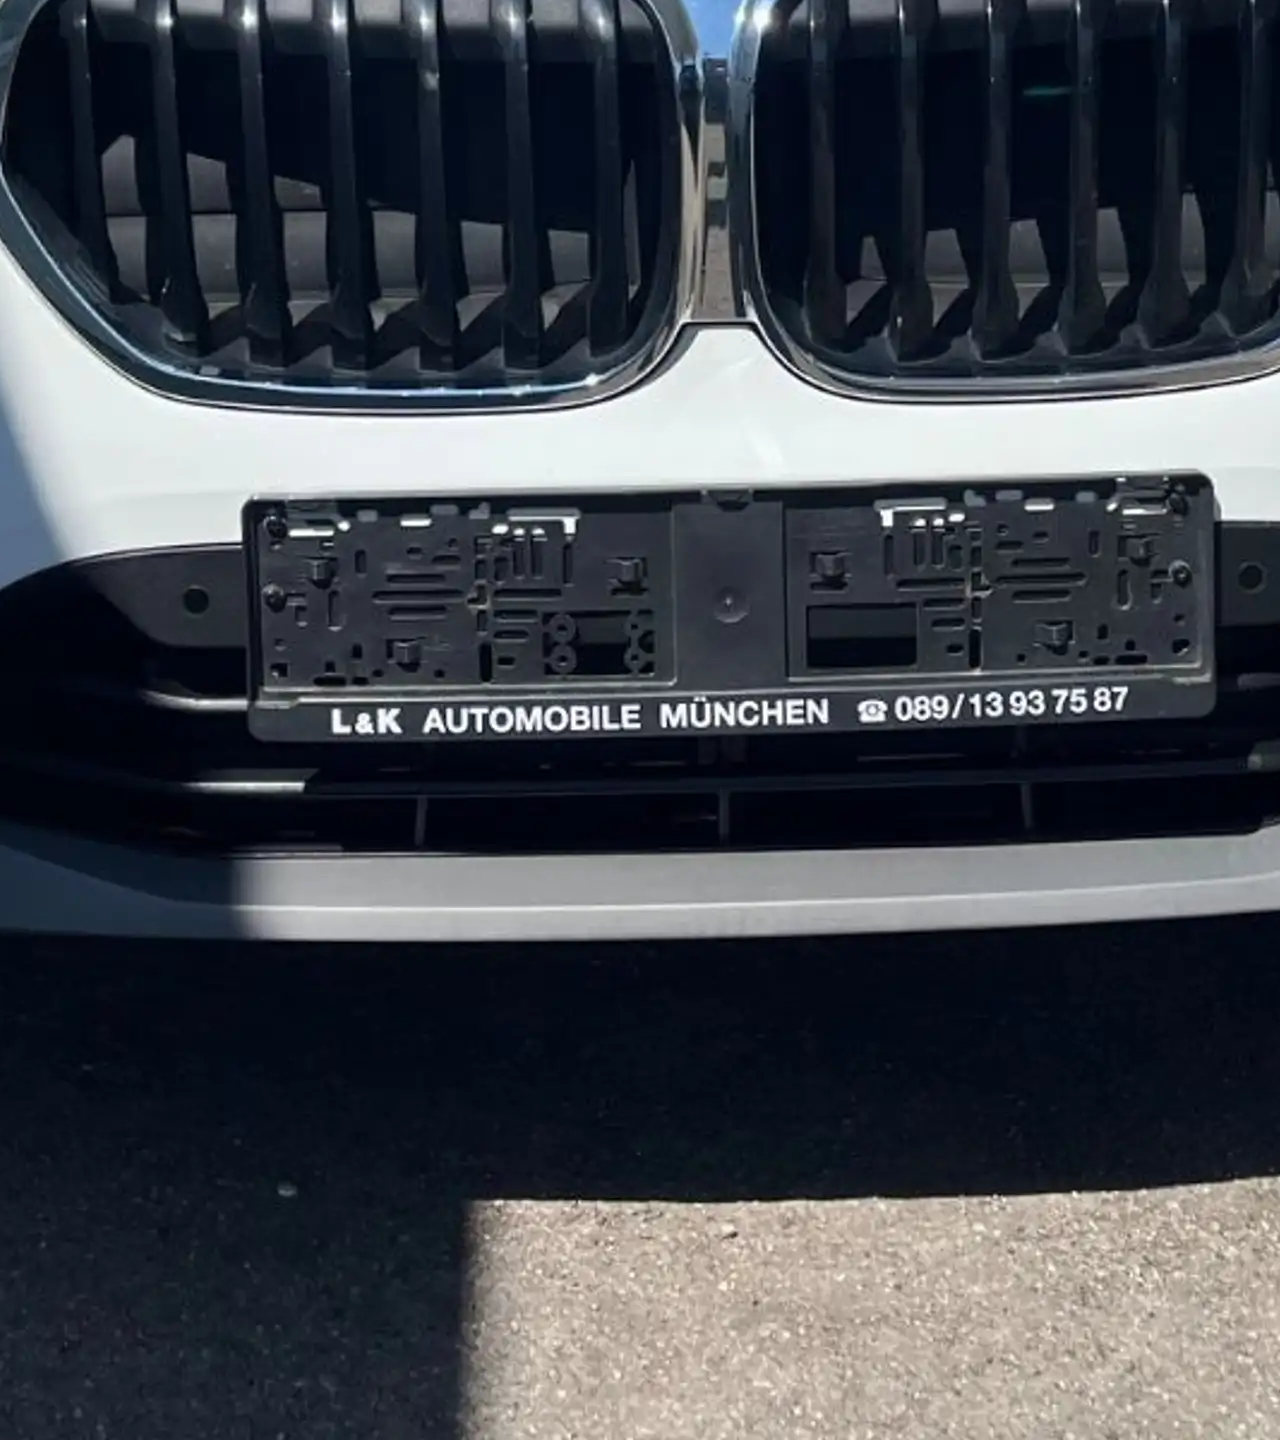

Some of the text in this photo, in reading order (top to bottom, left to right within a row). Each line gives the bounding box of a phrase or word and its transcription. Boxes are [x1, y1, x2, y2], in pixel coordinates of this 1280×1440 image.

[331, 707, 403, 735] L&K
[422, 703, 642, 734] AUTOMOBILE
[659, 695, 830, 730] MÜNCHEN
